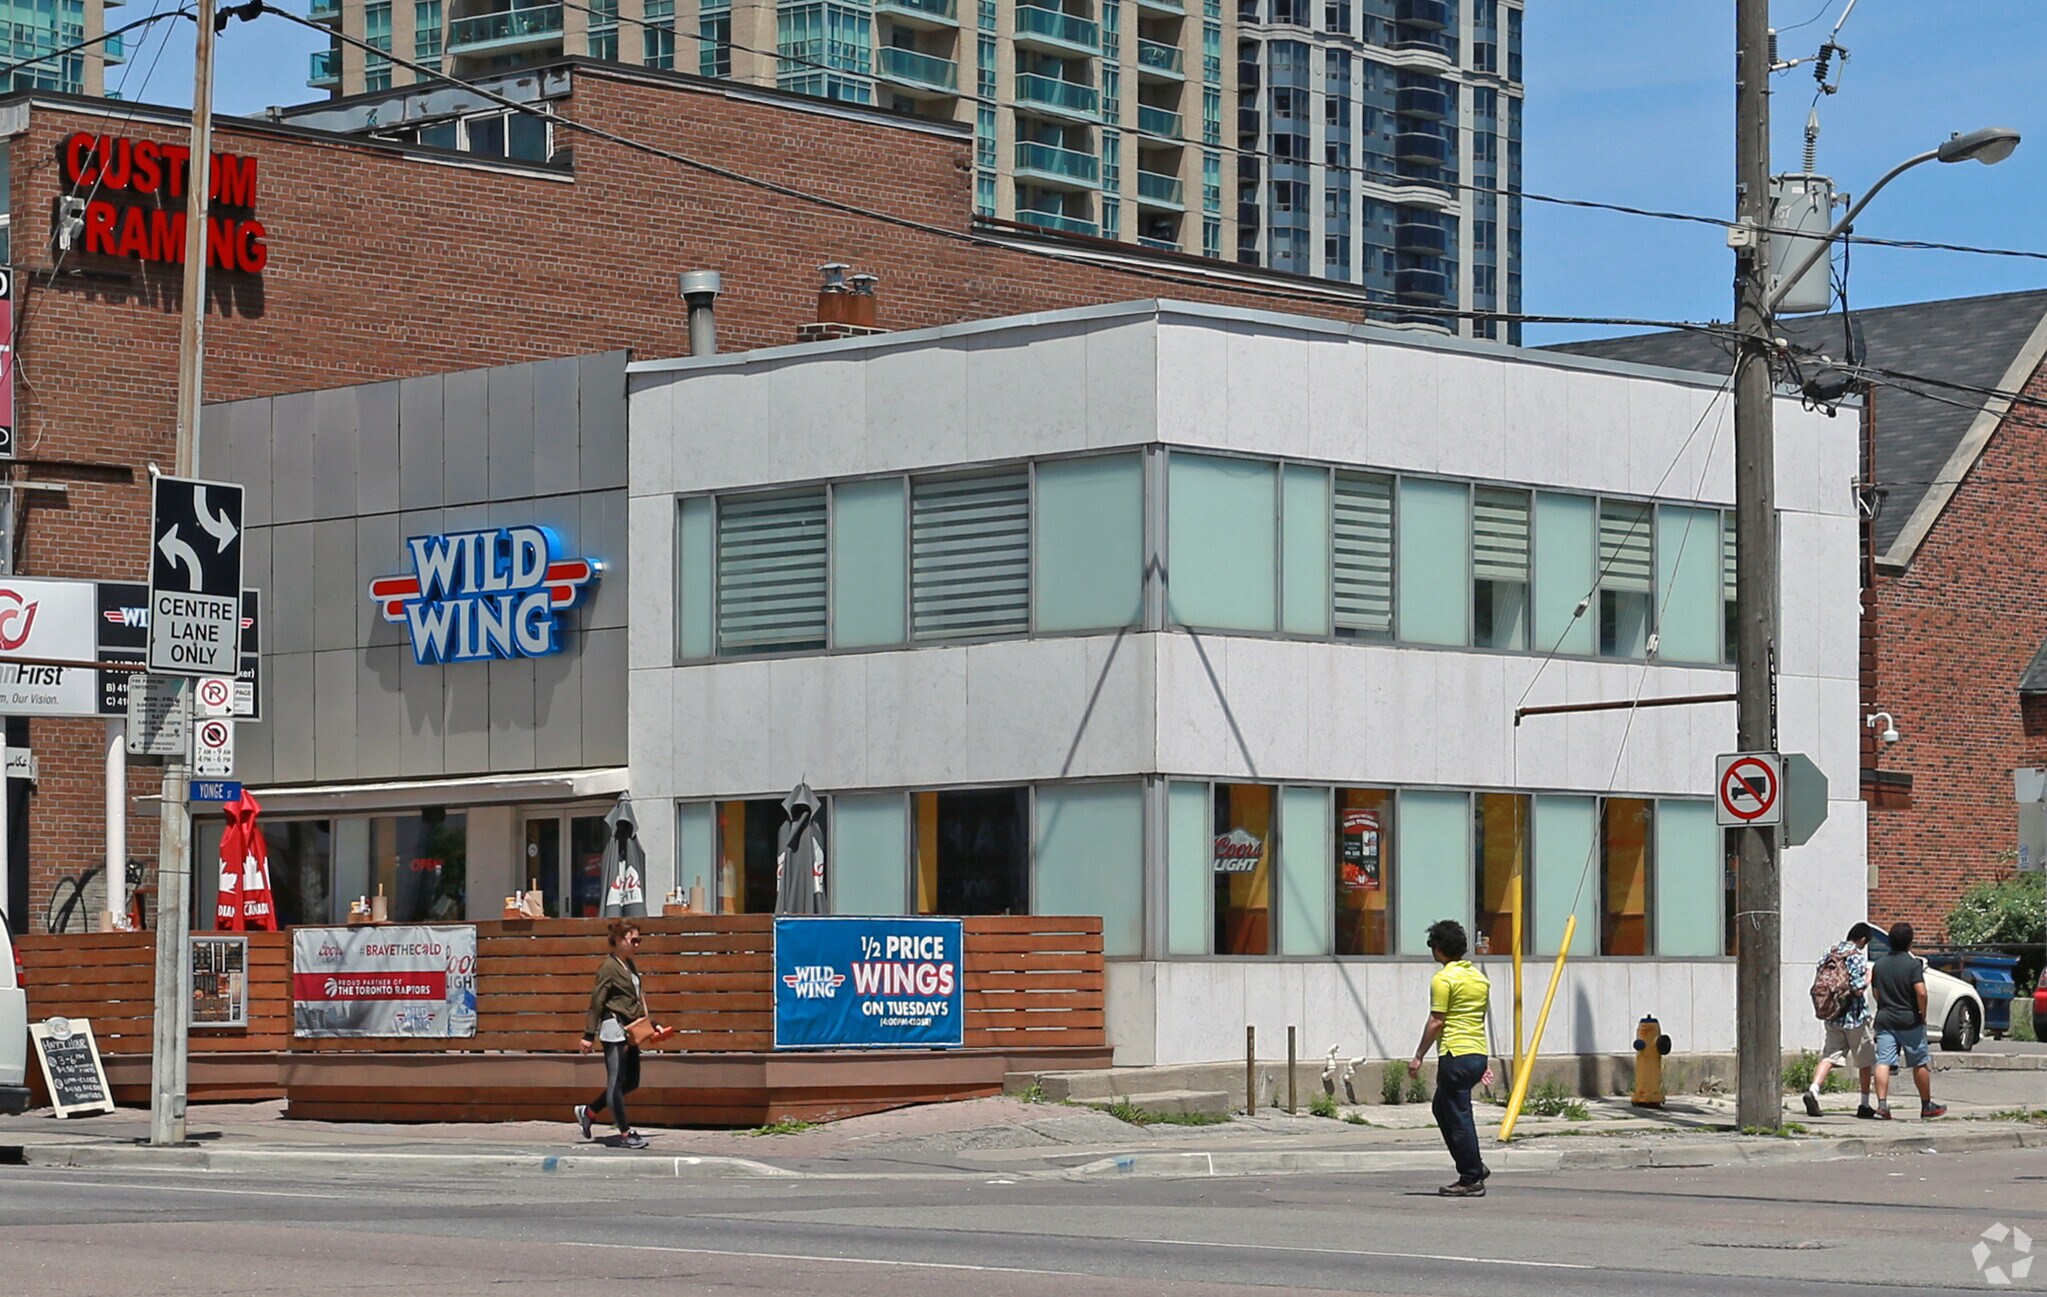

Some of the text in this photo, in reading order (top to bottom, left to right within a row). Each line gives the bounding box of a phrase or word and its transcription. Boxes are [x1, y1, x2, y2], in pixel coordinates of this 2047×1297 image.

[408, 528, 548, 598] WILD
[159, 597, 232, 621] CENTRE
[171, 621, 219, 642] LANE
[406, 592, 552, 661] WING
[171, 644, 217, 665] ONLY
[0, 664, 63, 685] nFirst
[117, 683, 129, 692] 41
[12, 693, 29, 704] Our
[30, 693, 59, 705] Vision.
[117, 697, 129, 706] 41
[199, 783, 224, 798] YONGE
[1214, 836, 1263, 858] Coors
[1214, 858, 1258, 872] LIGHT
[886, 936, 944, 960] PRICE
[363, 978, 391, 986] PARTNER
[794, 966, 834, 982] WILD
[851, 962, 955, 995] WINGS
[338, 985, 430, 995] THE TORONTO RAPTORS
[795, 981, 835, 998] WING
[403, 1006, 428, 1018] WILD
[862, 1001, 948, 1016] ON TUESDAYS
